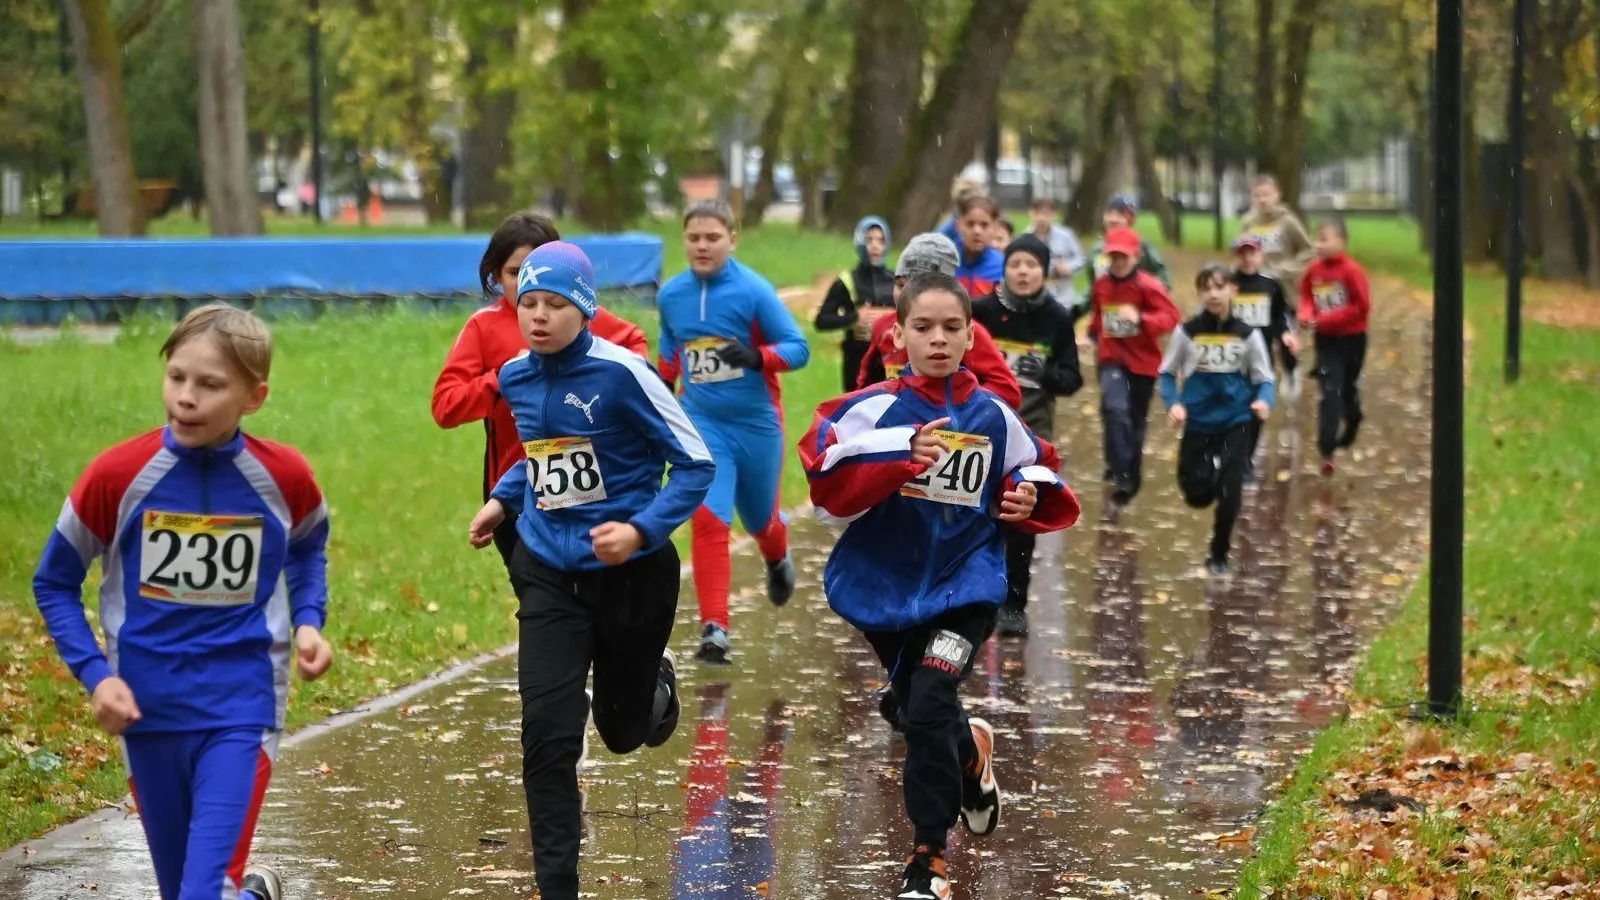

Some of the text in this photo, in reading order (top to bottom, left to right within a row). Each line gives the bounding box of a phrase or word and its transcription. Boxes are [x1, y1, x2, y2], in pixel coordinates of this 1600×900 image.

[1196, 344, 1241, 367] 235
[908, 449, 984, 493] 40
[147, 529, 254, 591] 239
